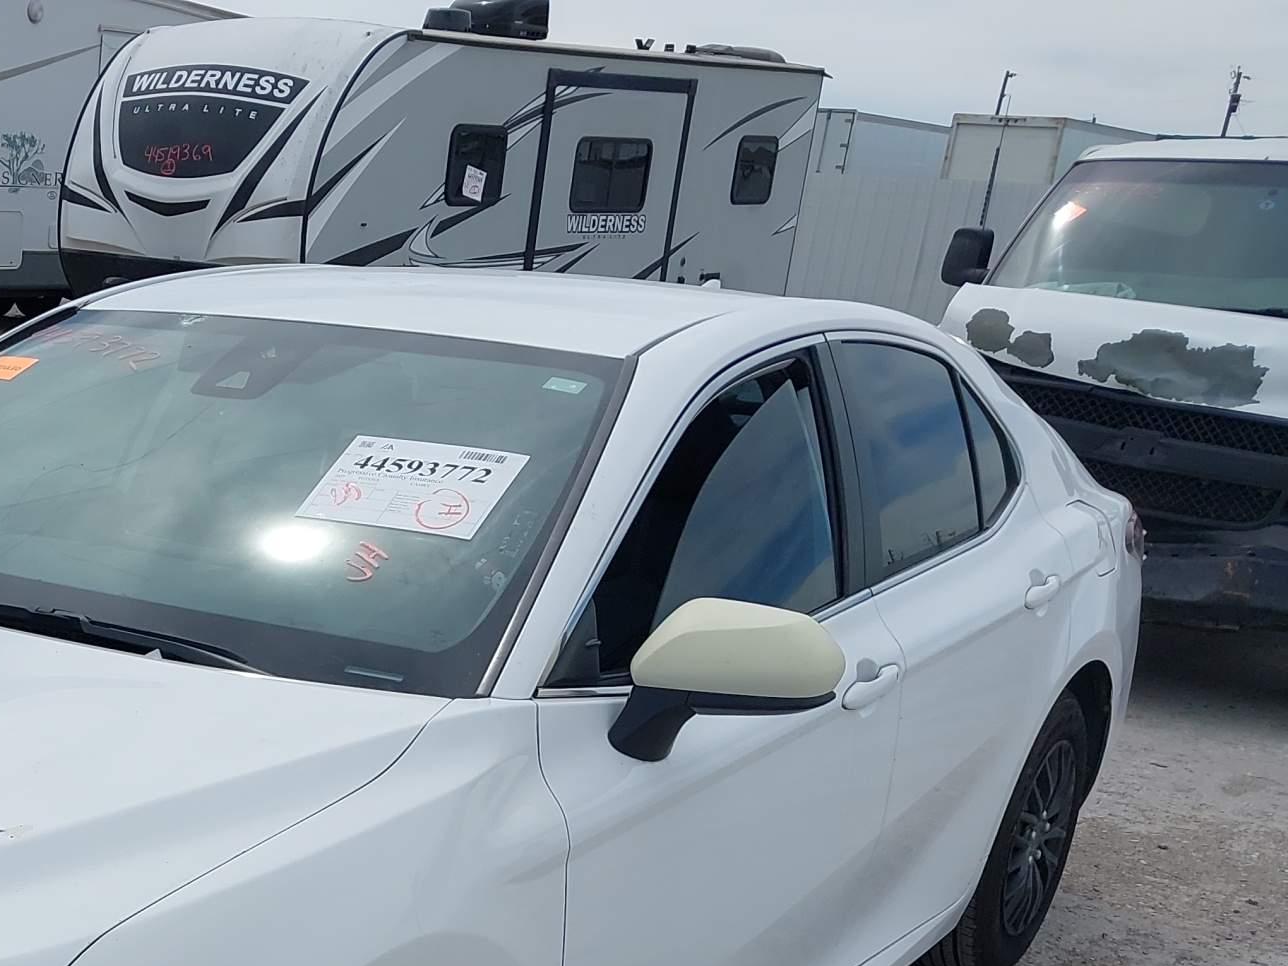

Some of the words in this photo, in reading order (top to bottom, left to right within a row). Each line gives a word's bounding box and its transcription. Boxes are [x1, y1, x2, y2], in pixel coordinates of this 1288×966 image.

[132, 70, 294, 98] WILDERNESS
[133, 103, 189, 114] ULTRA
[203, 104, 258, 119] LITE
[567, 215, 646, 234] WILDERNESS
[354, 455, 494, 484] 44593772
